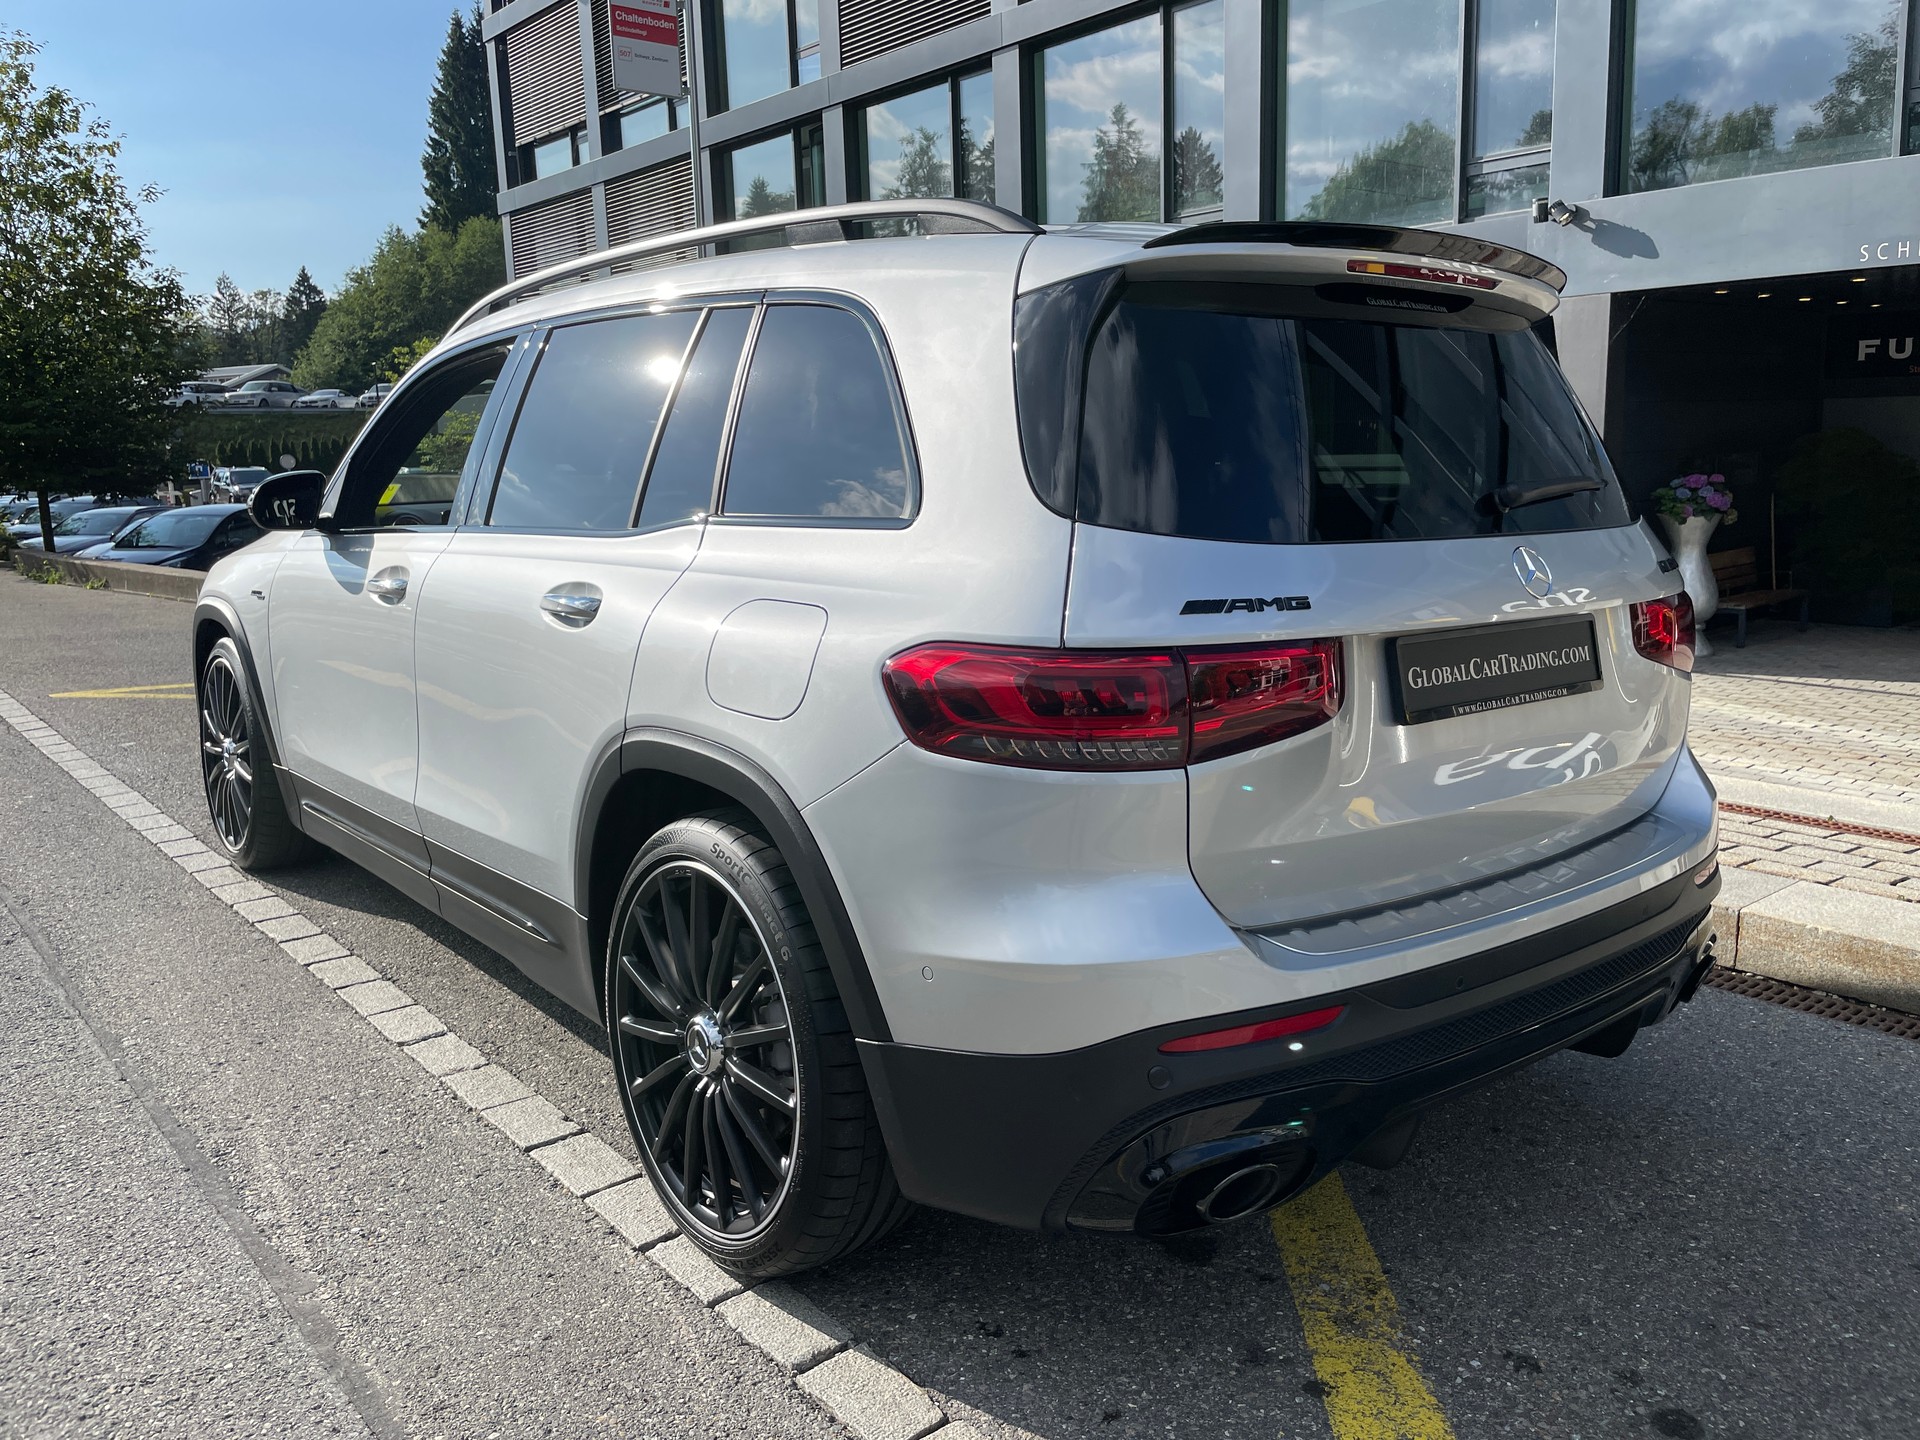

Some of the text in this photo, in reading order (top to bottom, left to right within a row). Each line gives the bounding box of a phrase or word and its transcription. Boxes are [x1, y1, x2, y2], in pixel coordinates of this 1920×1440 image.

[615, 10, 675, 30] Chaltenboden
[619, 49, 631, 58] 507
[1857, 337, 1914, 361] FU
[1224, 595, 1311, 614] AMG
[1407, 645, 1591, 689] GLOBALCARTRADING.COM
